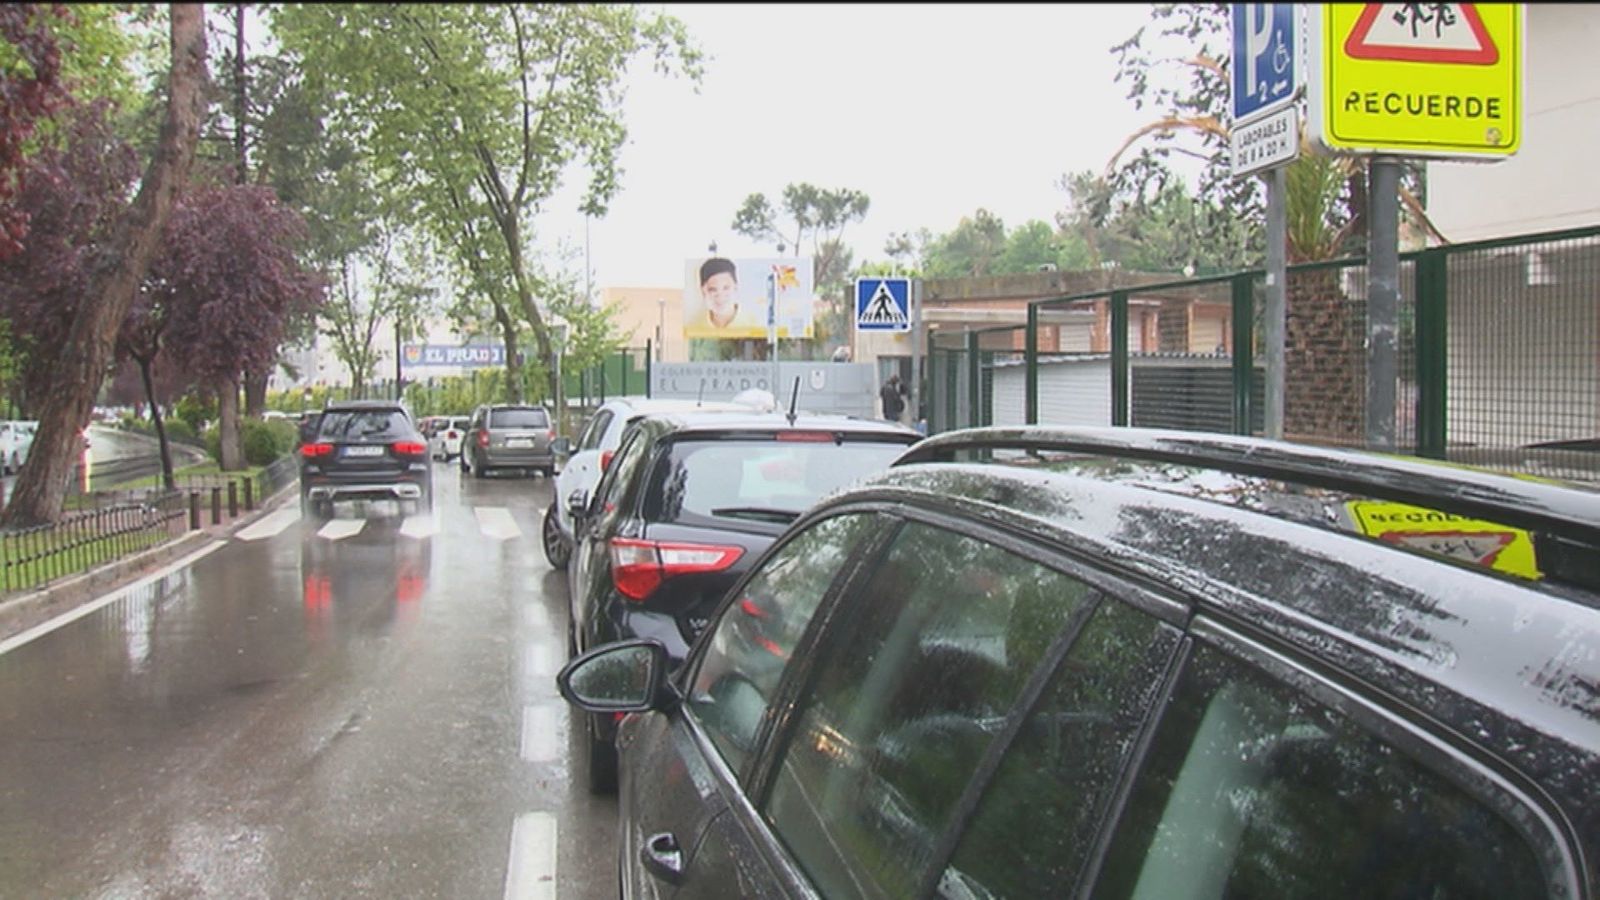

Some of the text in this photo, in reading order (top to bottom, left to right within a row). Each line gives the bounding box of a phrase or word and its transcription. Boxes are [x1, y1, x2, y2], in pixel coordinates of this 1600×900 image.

[1246, 3, 1274, 97] P
[1259, 80, 1268, 103] 2
[1344, 91, 1501, 119] RECUERDE
[1237, 118, 1288, 149] LABORABLES
[1237, 149, 1248, 167] DE
[424, 348, 444, 362] EL
[660, 378, 768, 391] EL PRADO
